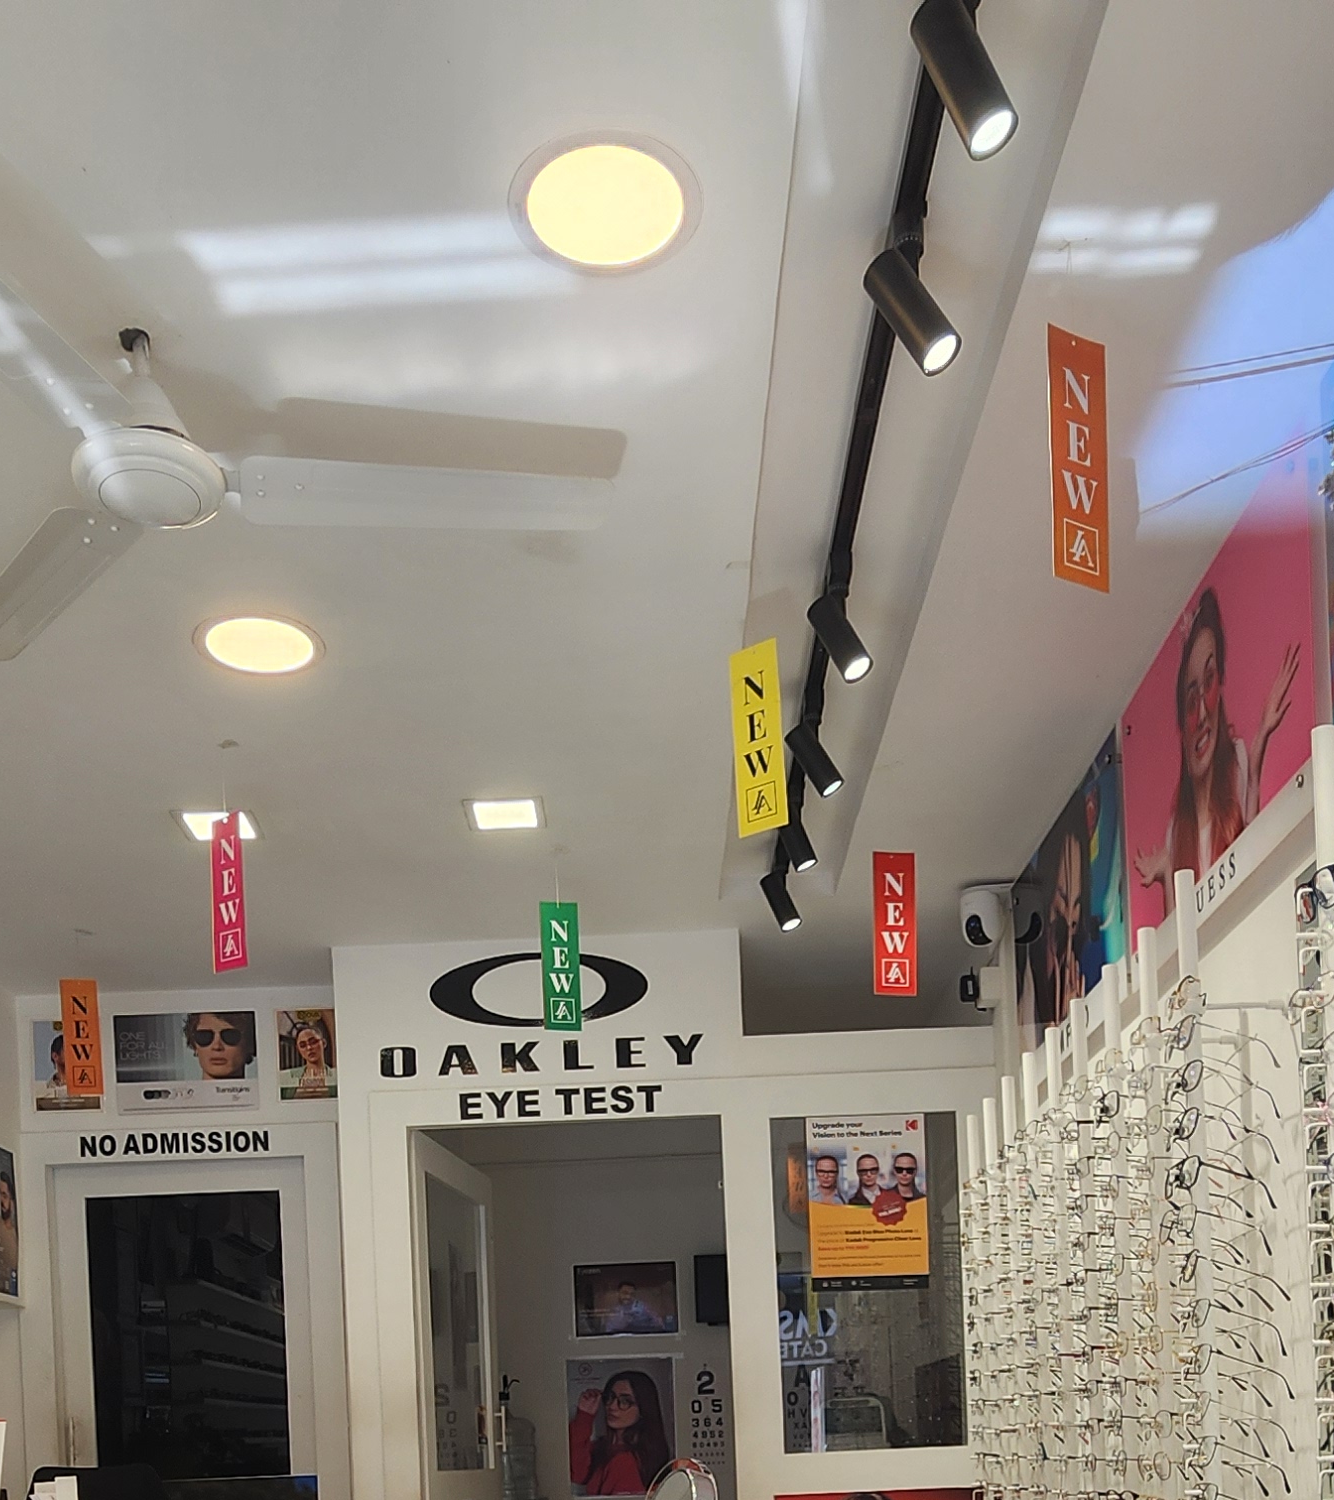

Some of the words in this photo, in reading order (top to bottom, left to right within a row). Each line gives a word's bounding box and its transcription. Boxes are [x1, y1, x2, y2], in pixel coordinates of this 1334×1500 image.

[1061, 366, 1098, 515] NEW
[743, 669, 774, 778] NEW
[218, 834, 240, 926] NEW
[1196, 852, 1236, 913] UESS
[881, 872, 909, 954] NEW
[549, 920, 574, 993] NEW
[70, 995, 93, 1061] NEW
[119, 1041, 146, 1051] FOR
[379, 1034, 705, 1079] OAKLEY
[458, 1088, 542, 1121] EYE
[555, 1084, 663, 1116] TEST
[79, 1134, 117, 1158] NO
[122, 1129, 271, 1156] ADMISSION
[811, 1121, 846, 1131] Upgrade
[845, 1122, 863, 1131] your
[811, 1131, 836, 1139] Vision
[878, 1129, 903, 1137] Series
[695, 1371, 715, 1396] 2
[710, 1400, 723, 1413] 5
